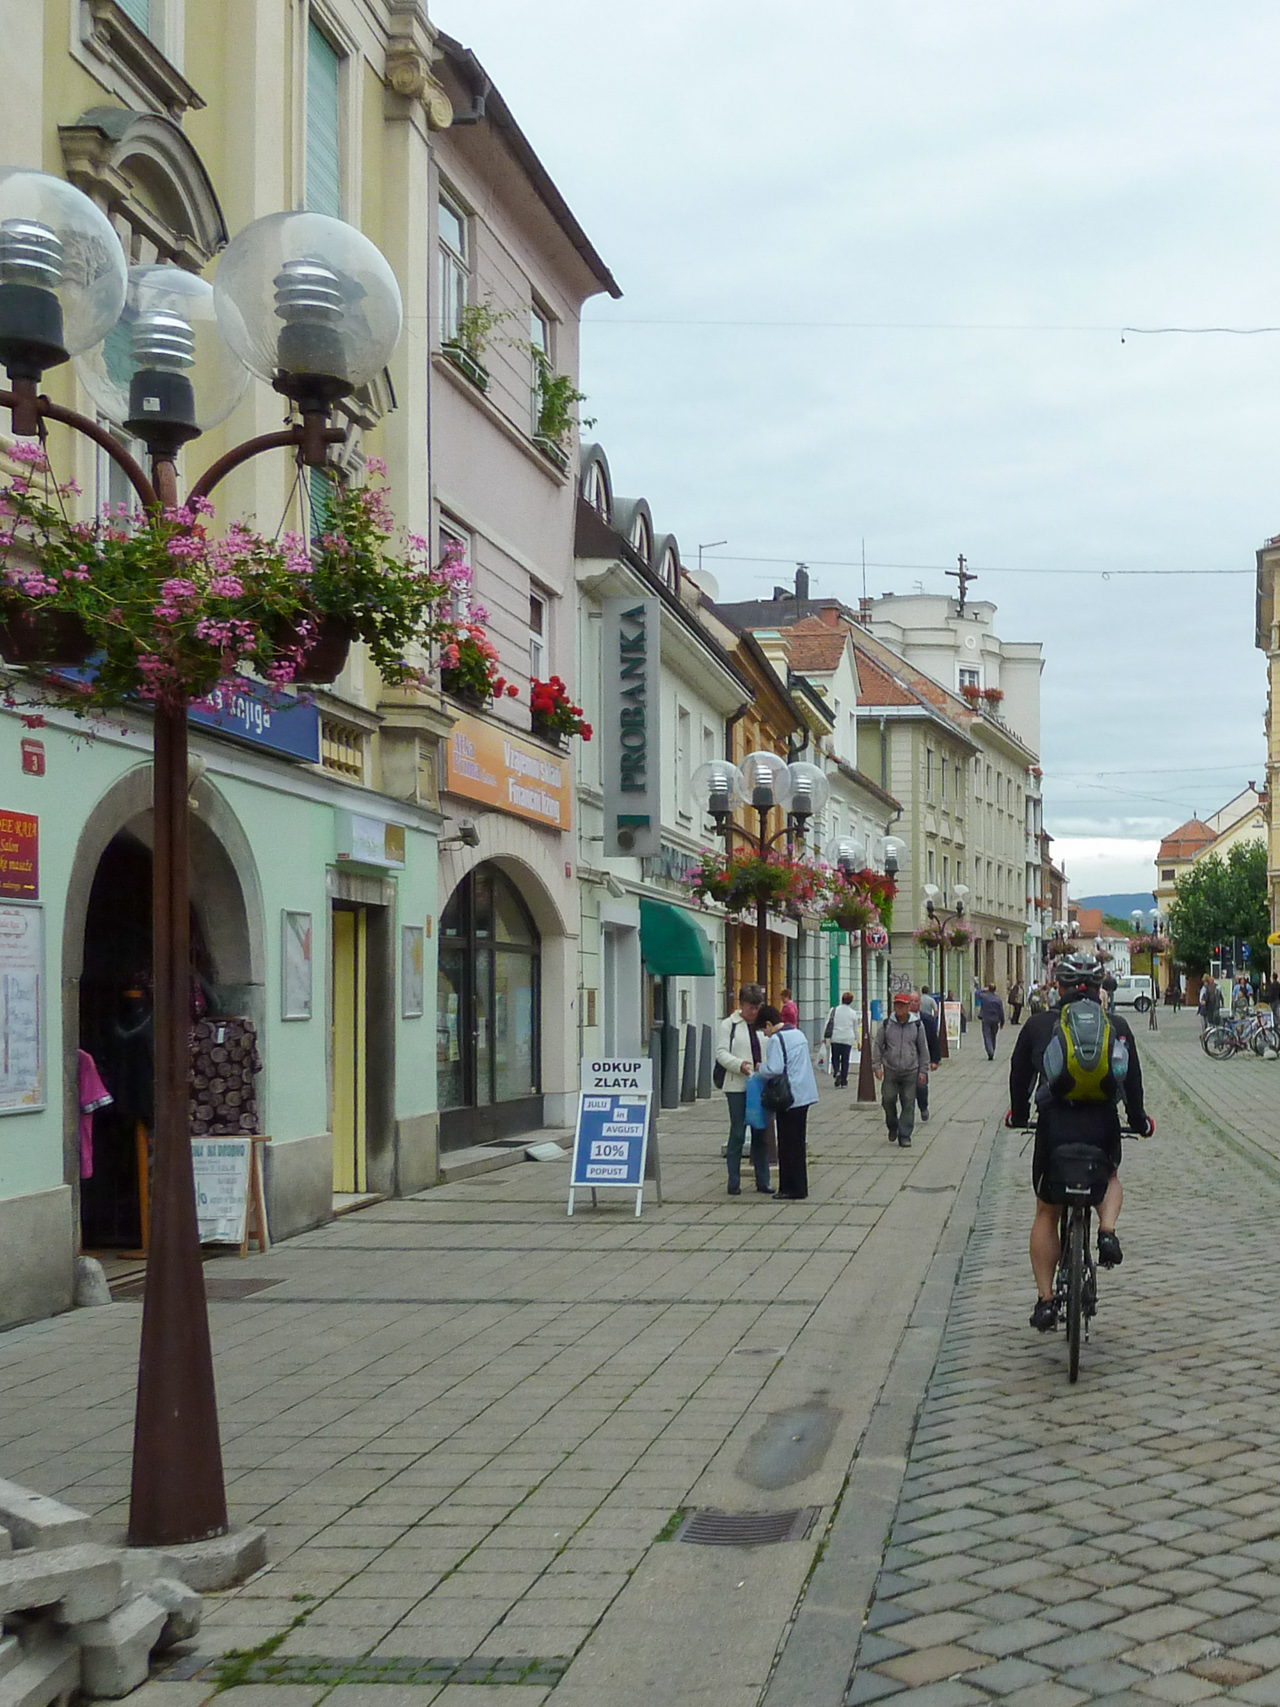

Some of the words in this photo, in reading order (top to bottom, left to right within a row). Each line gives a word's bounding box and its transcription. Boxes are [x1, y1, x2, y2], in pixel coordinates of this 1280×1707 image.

[620, 603, 647, 792] PROBANKA
[32, 755, 38, 771] 3
[591, 1062, 642, 1073] ODKUP
[594, 1077, 639, 1088] ZLATA
[616, 1110, 625, 1119] in
[606, 1126, 640, 1134] AVGUST
[595, 1144, 625, 1157] 10%
[590, 1167, 623, 1176] POPUST
